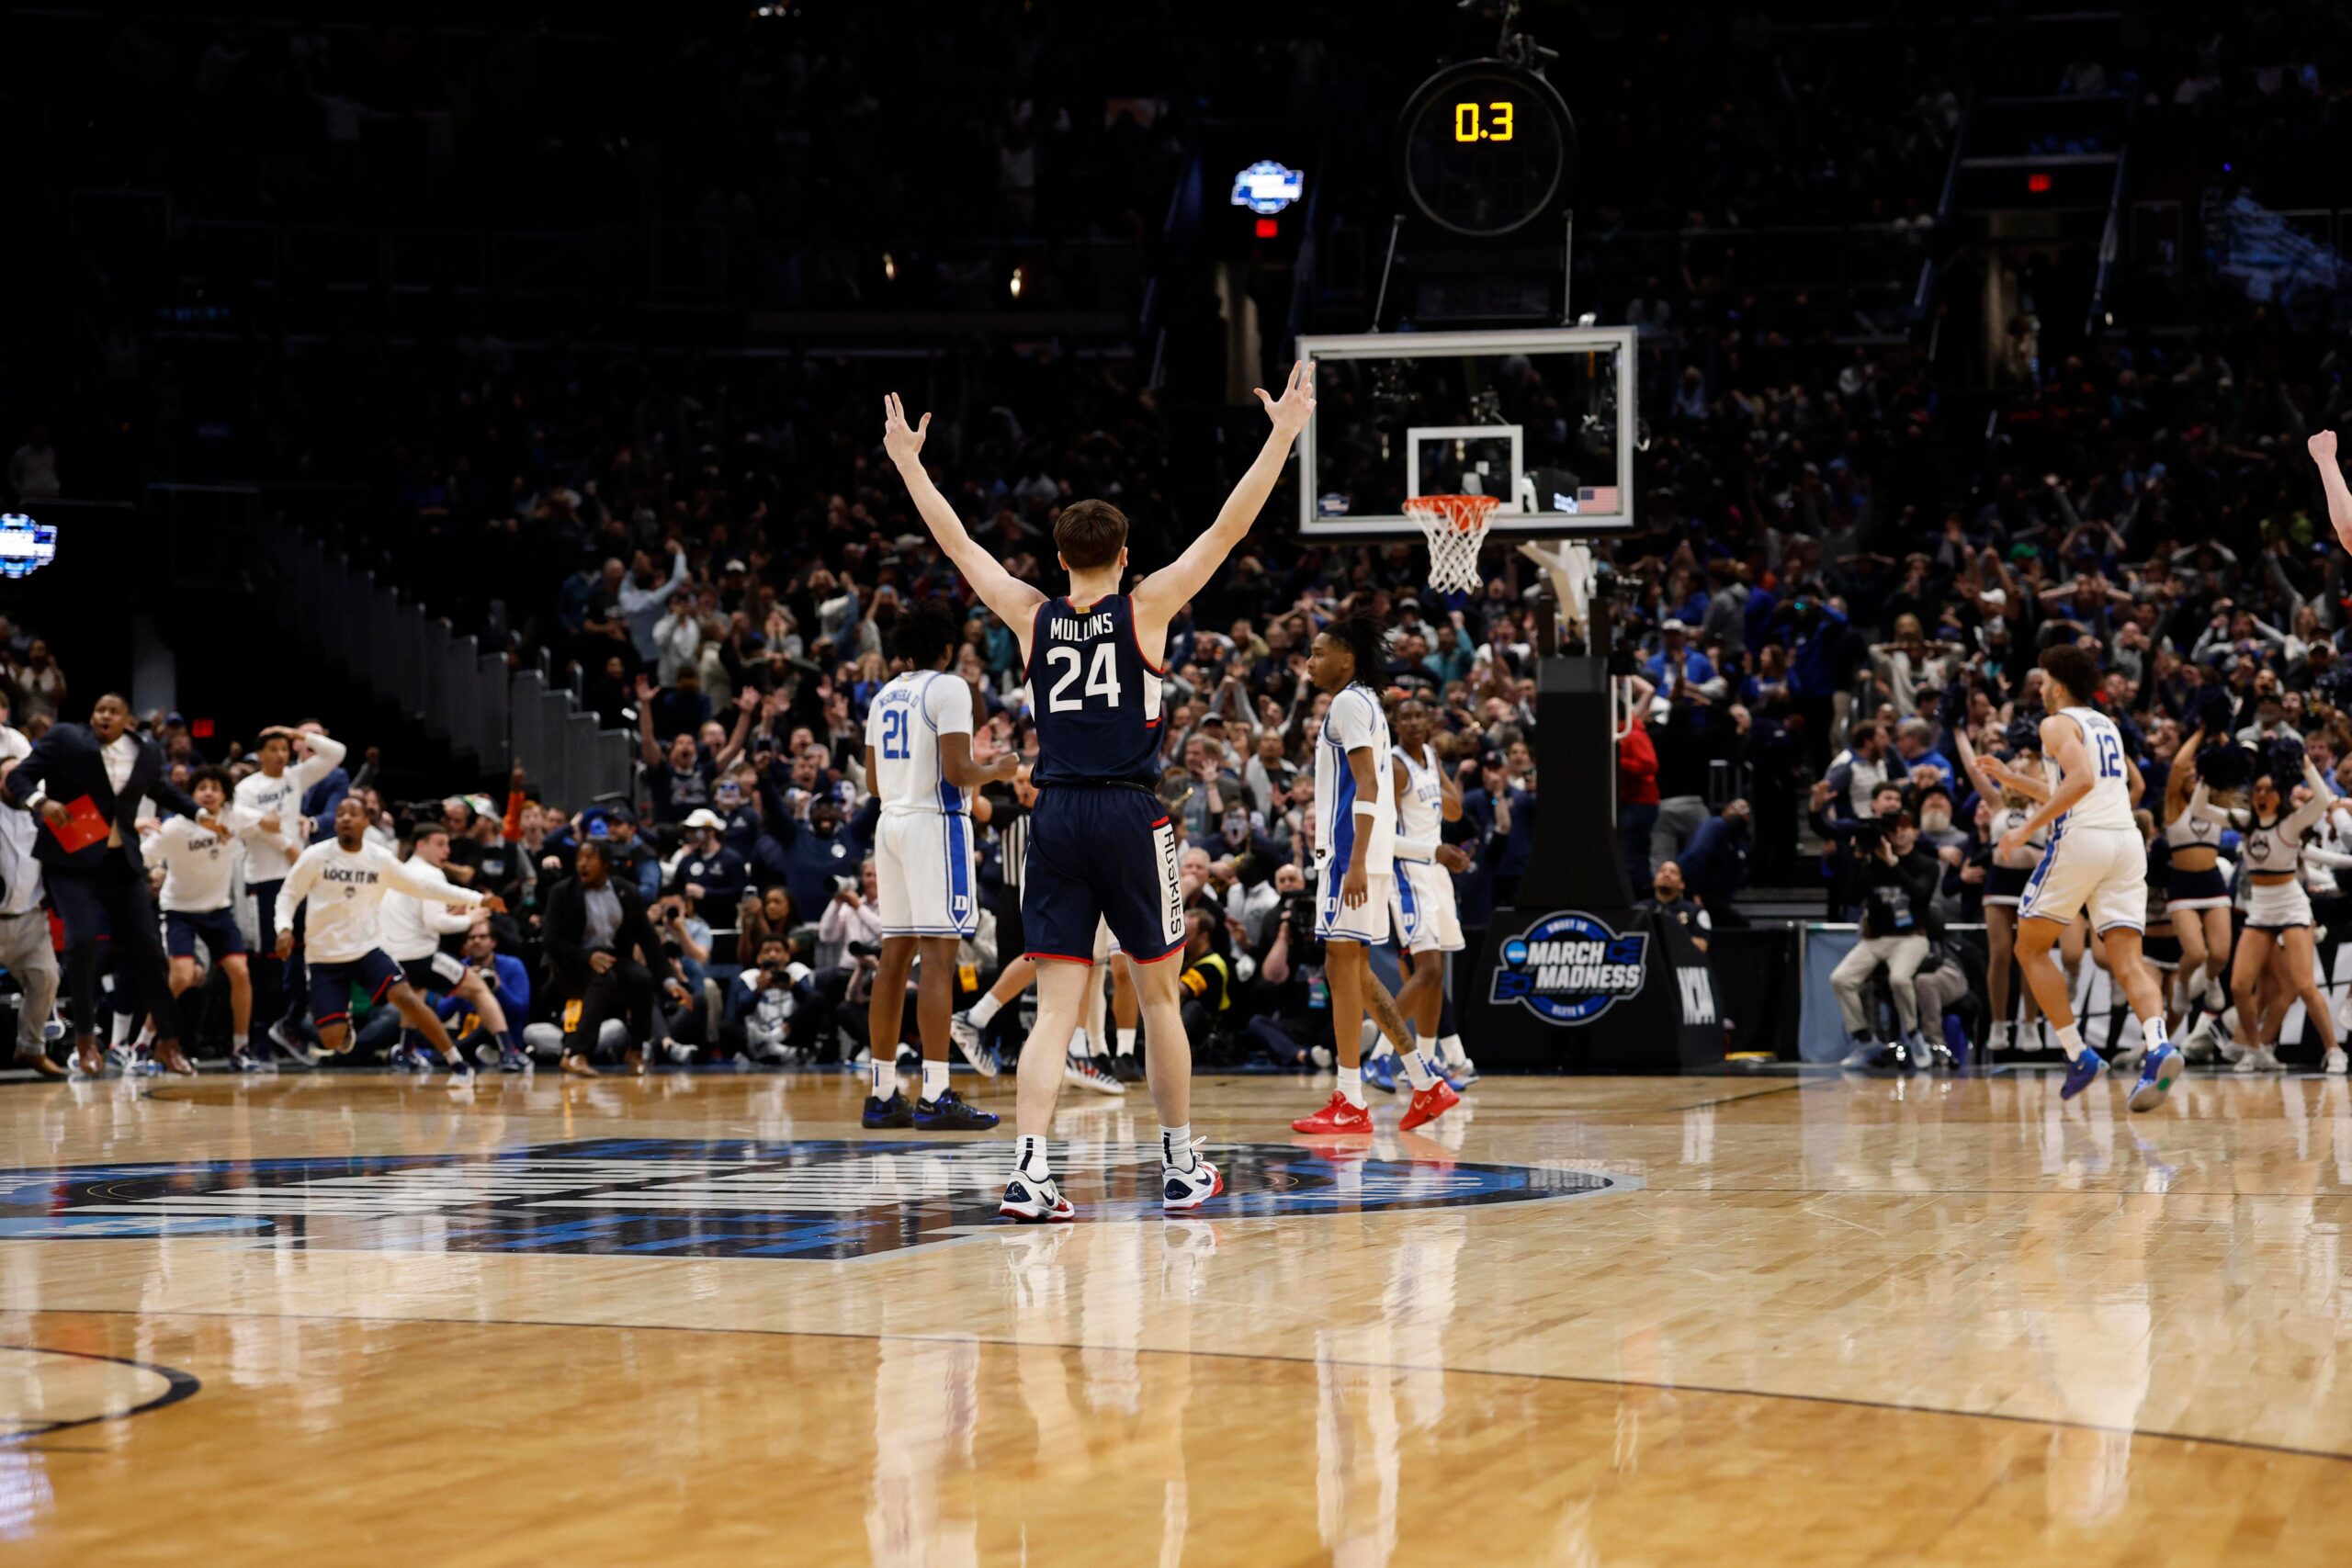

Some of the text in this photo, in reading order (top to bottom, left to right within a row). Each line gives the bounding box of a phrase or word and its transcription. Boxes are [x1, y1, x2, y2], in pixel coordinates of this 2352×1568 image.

[1455, 101, 1513, 142] 0.3
[1049, 613, 1114, 641] MULLINS
[1046, 642, 1122, 713] 24
[882, 708, 910, 760] 21
[2096, 733, 2121, 778] 12
[323, 868, 353, 883] LOCK
[1164, 830, 1182, 935] HUSKIES
[954, 895, 968, 911] D
[1526, 941, 1607, 965] MARCH
[1535, 964, 1642, 990] MADNESS
